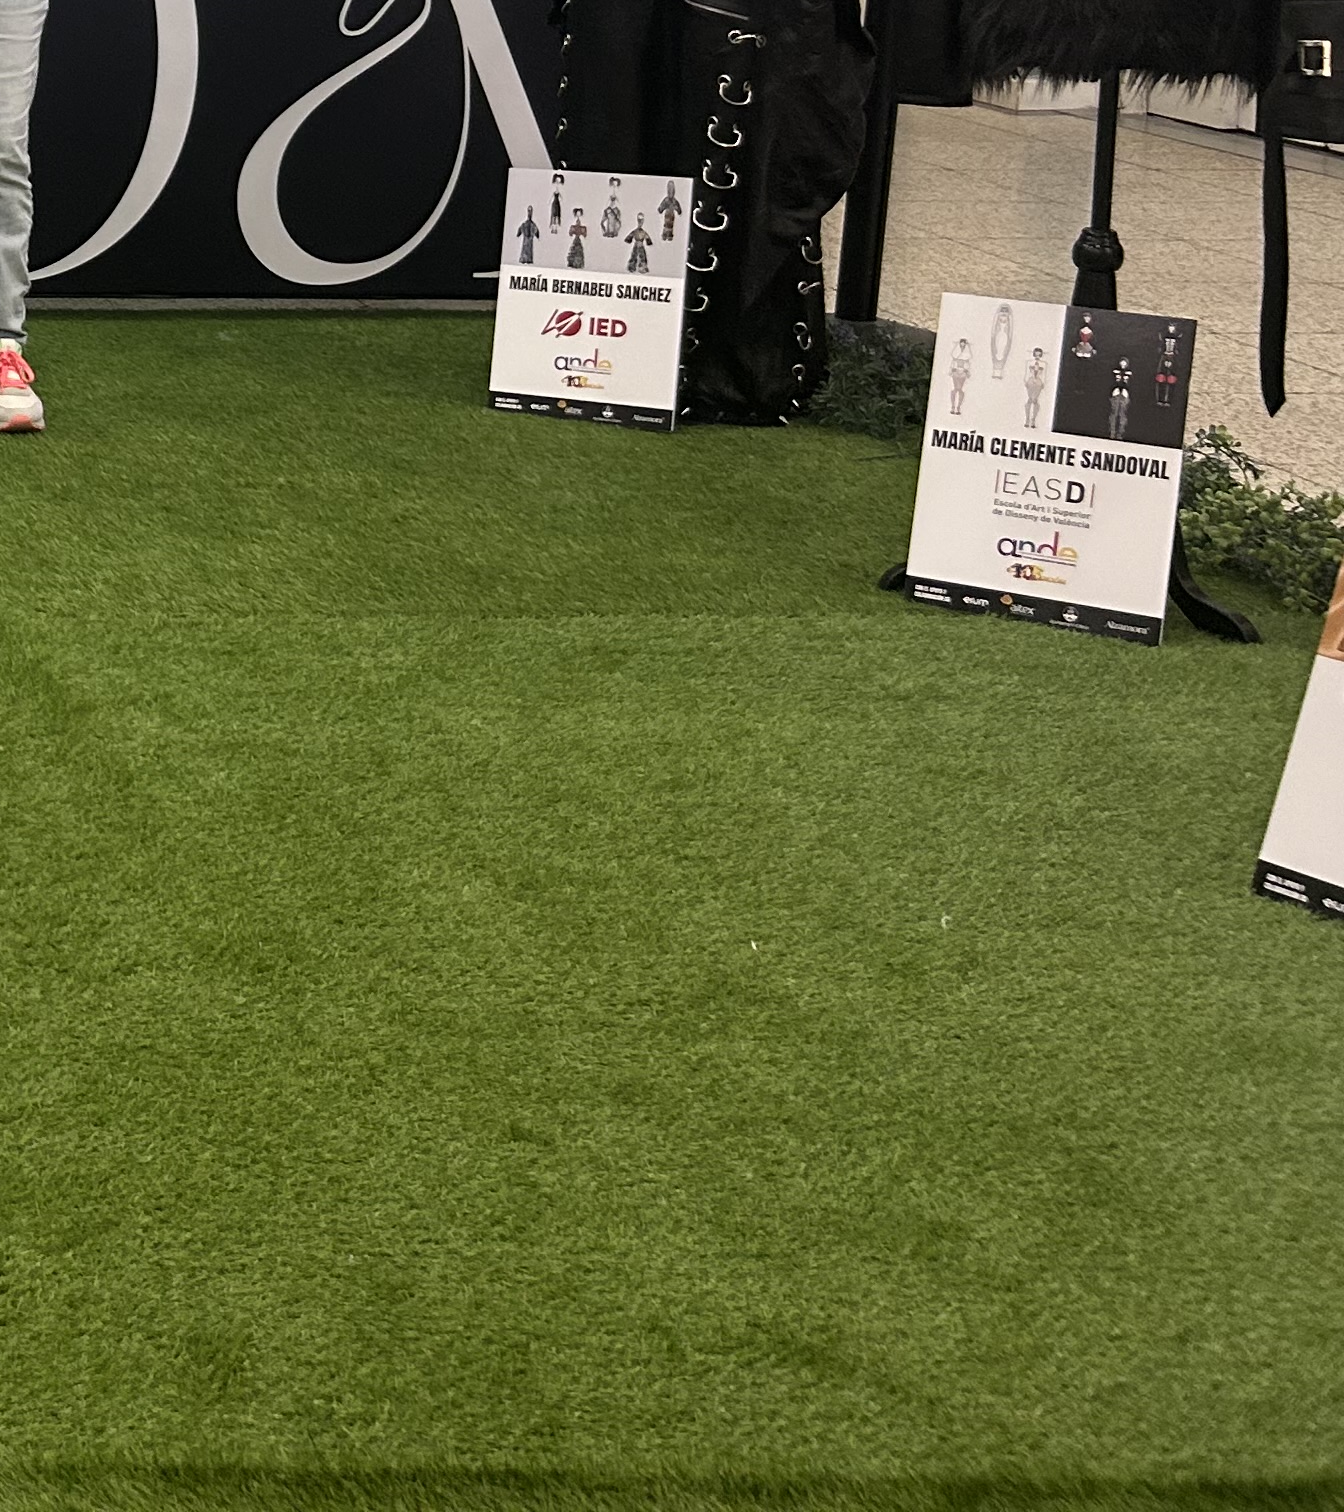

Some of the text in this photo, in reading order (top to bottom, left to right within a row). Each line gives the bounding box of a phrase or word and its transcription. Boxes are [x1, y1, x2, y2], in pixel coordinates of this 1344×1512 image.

[509, 275, 672, 303] MARÍA BERNABEU SANCHEZ
[588, 317, 627, 337] IED
[554, 348, 612, 371] ande
[931, 429, 1170, 480] MARÍA CLEMENTE SANDOVAL
[997, 531, 1079, 558] ande
